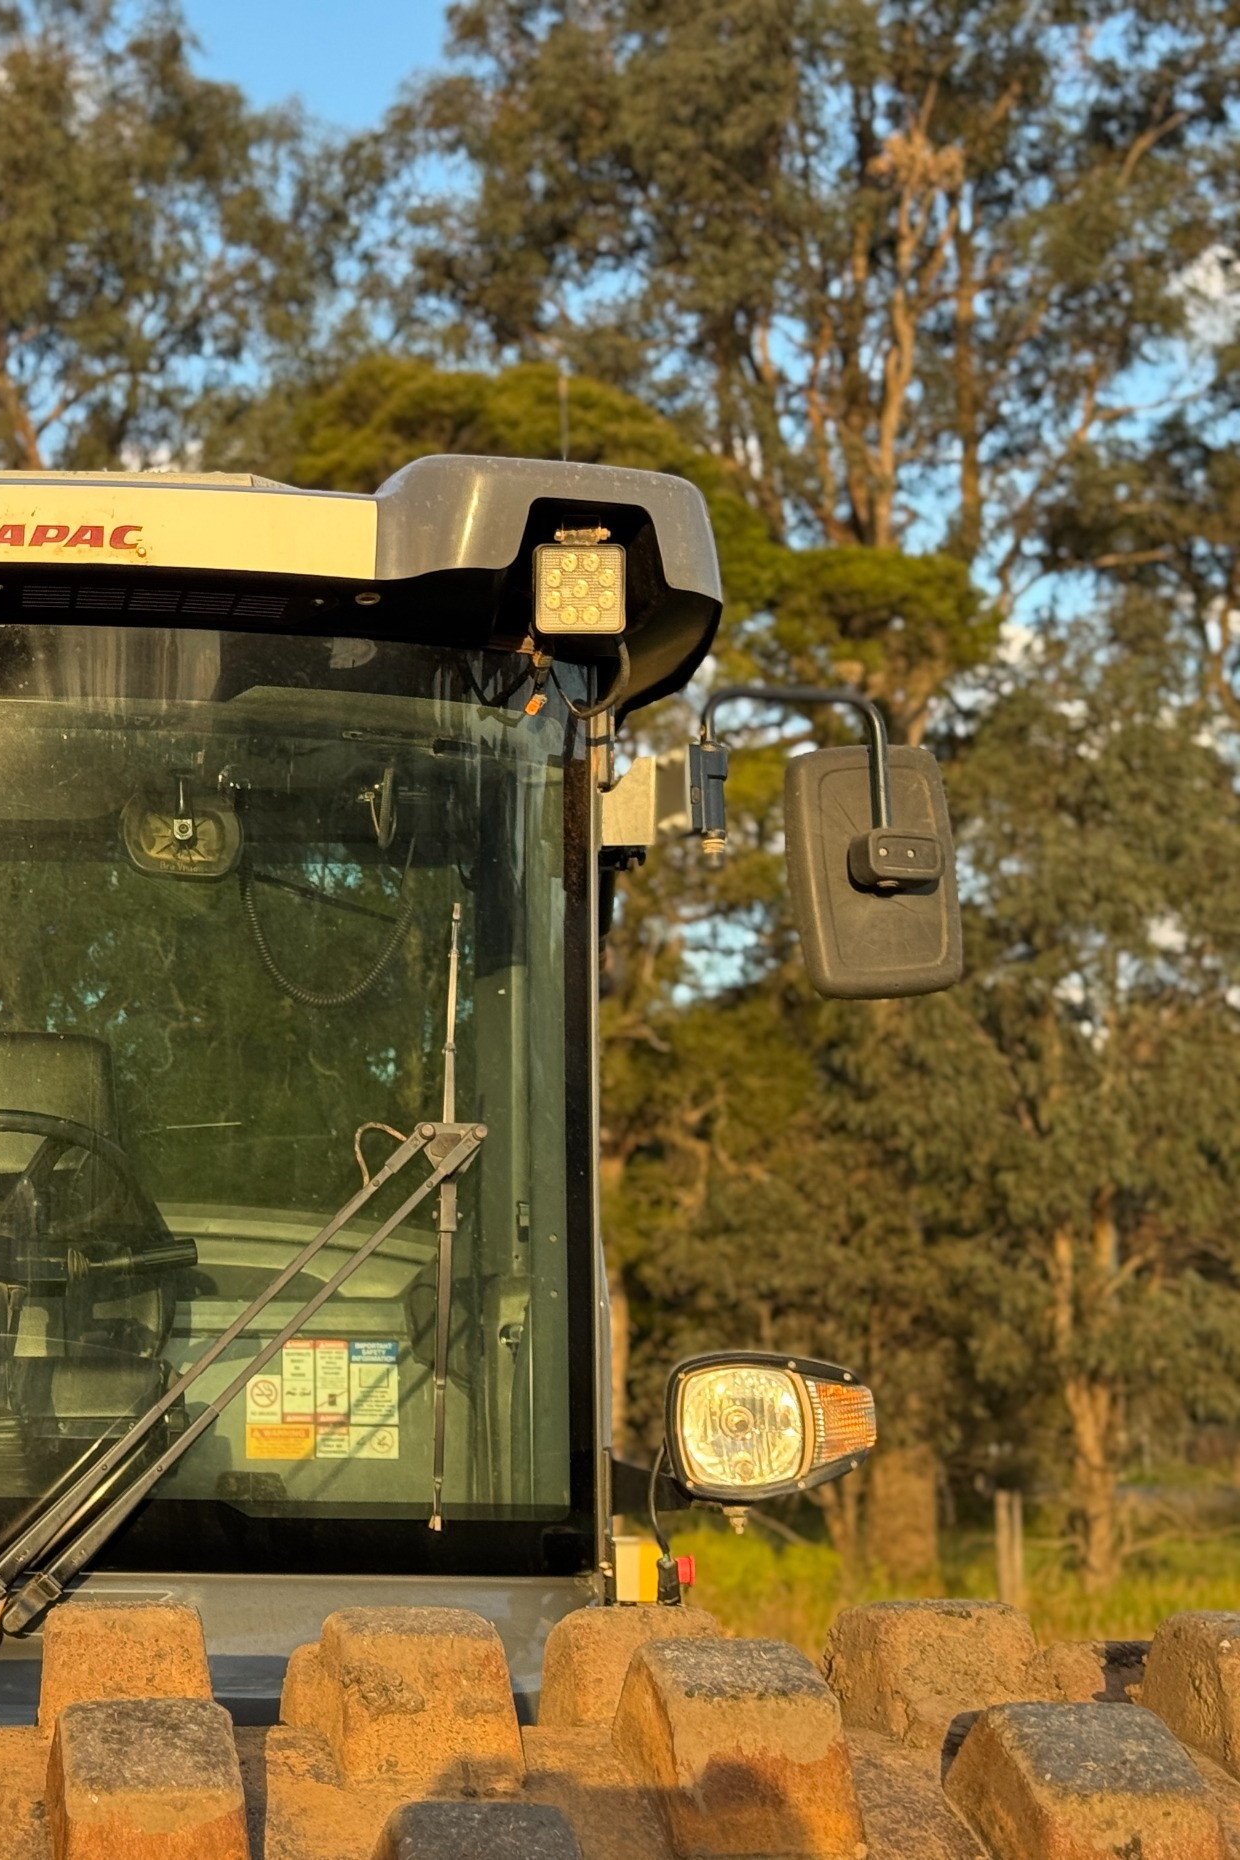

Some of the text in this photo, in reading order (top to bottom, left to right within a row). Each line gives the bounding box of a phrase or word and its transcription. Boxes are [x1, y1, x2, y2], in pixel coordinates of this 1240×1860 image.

[354, 1342, 392, 1350] IMPORTANT
[351, 1355, 396, 1363] INFORMATION
[263, 1429, 306, 1438] WARNING
